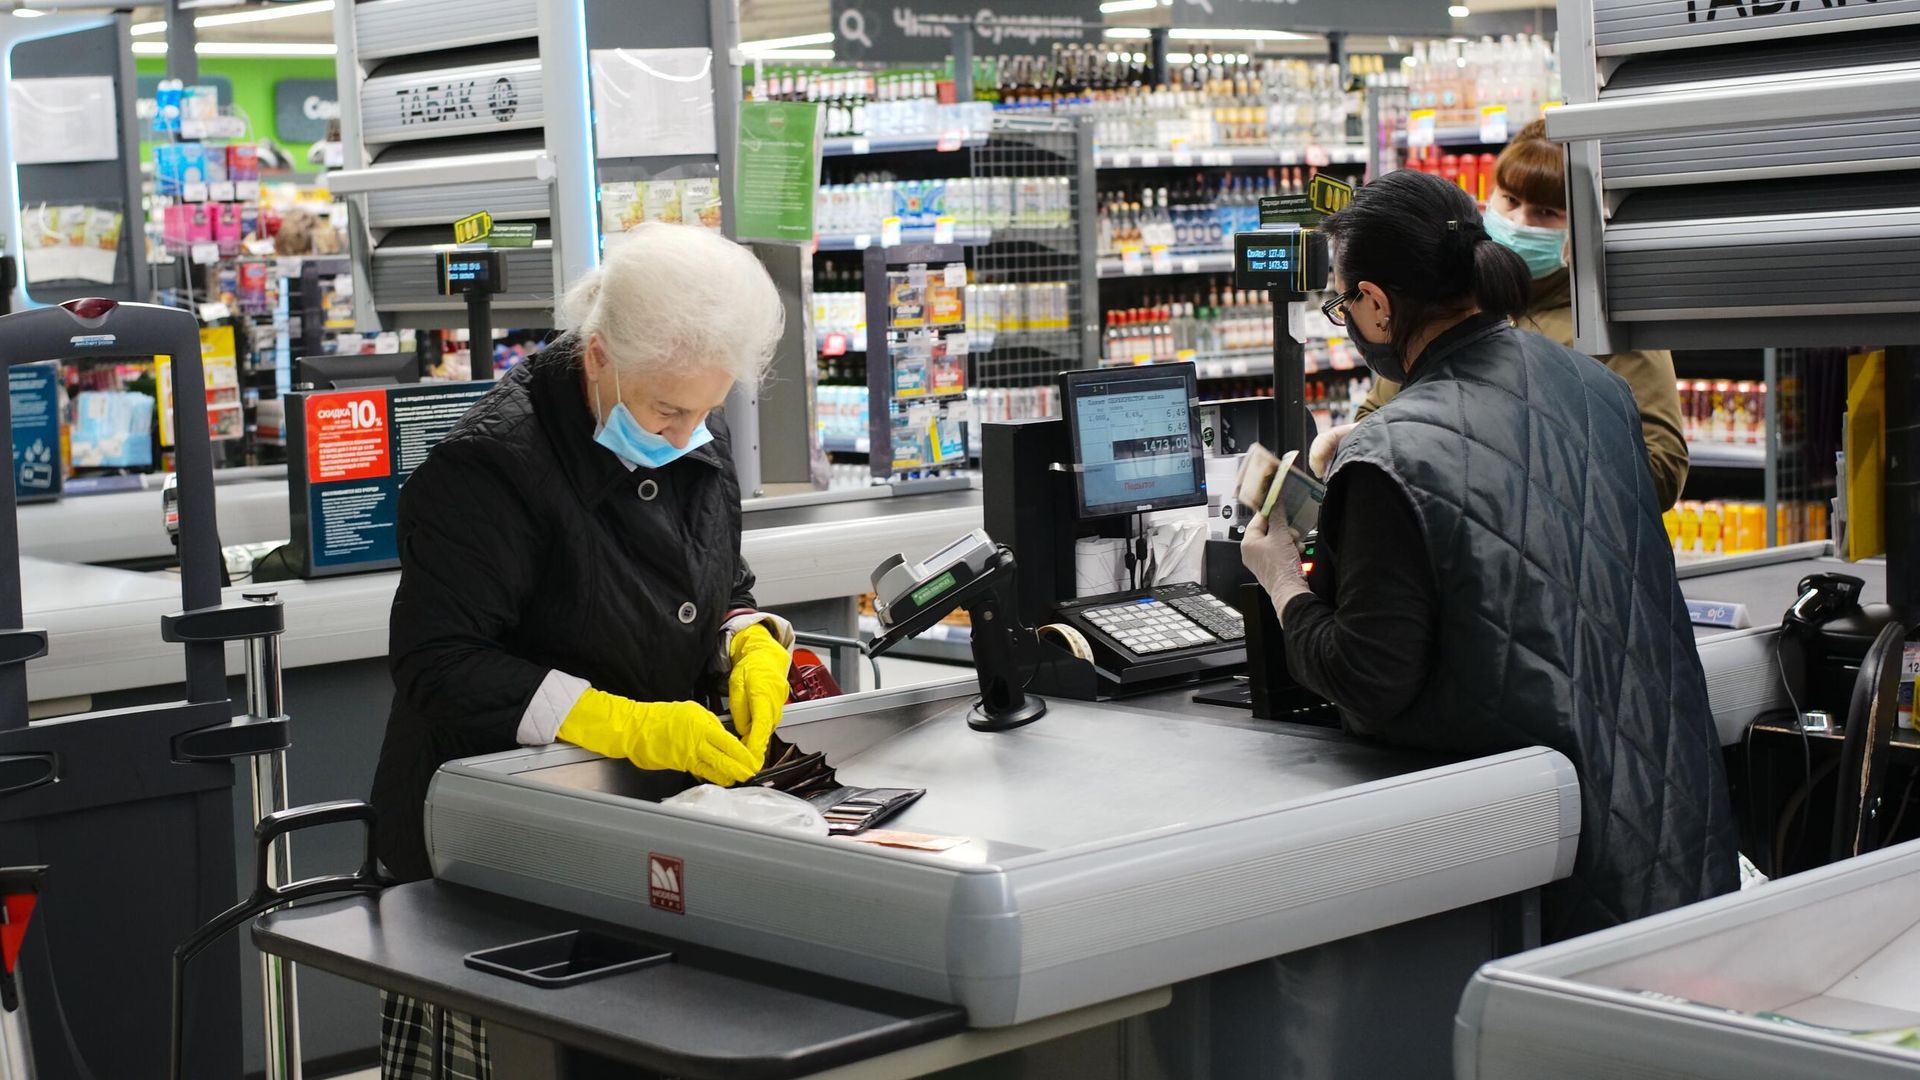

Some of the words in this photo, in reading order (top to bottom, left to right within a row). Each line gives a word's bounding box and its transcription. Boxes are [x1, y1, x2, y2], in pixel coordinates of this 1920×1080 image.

[396, 81, 477, 125] ТАБАК
[317, 408, 351, 419] СКИДКА
[1167, 408, 1186, 418] 6,49
[1168, 422, 1187, 432] 6,49
[1143, 438, 1188, 452] 1473,00
